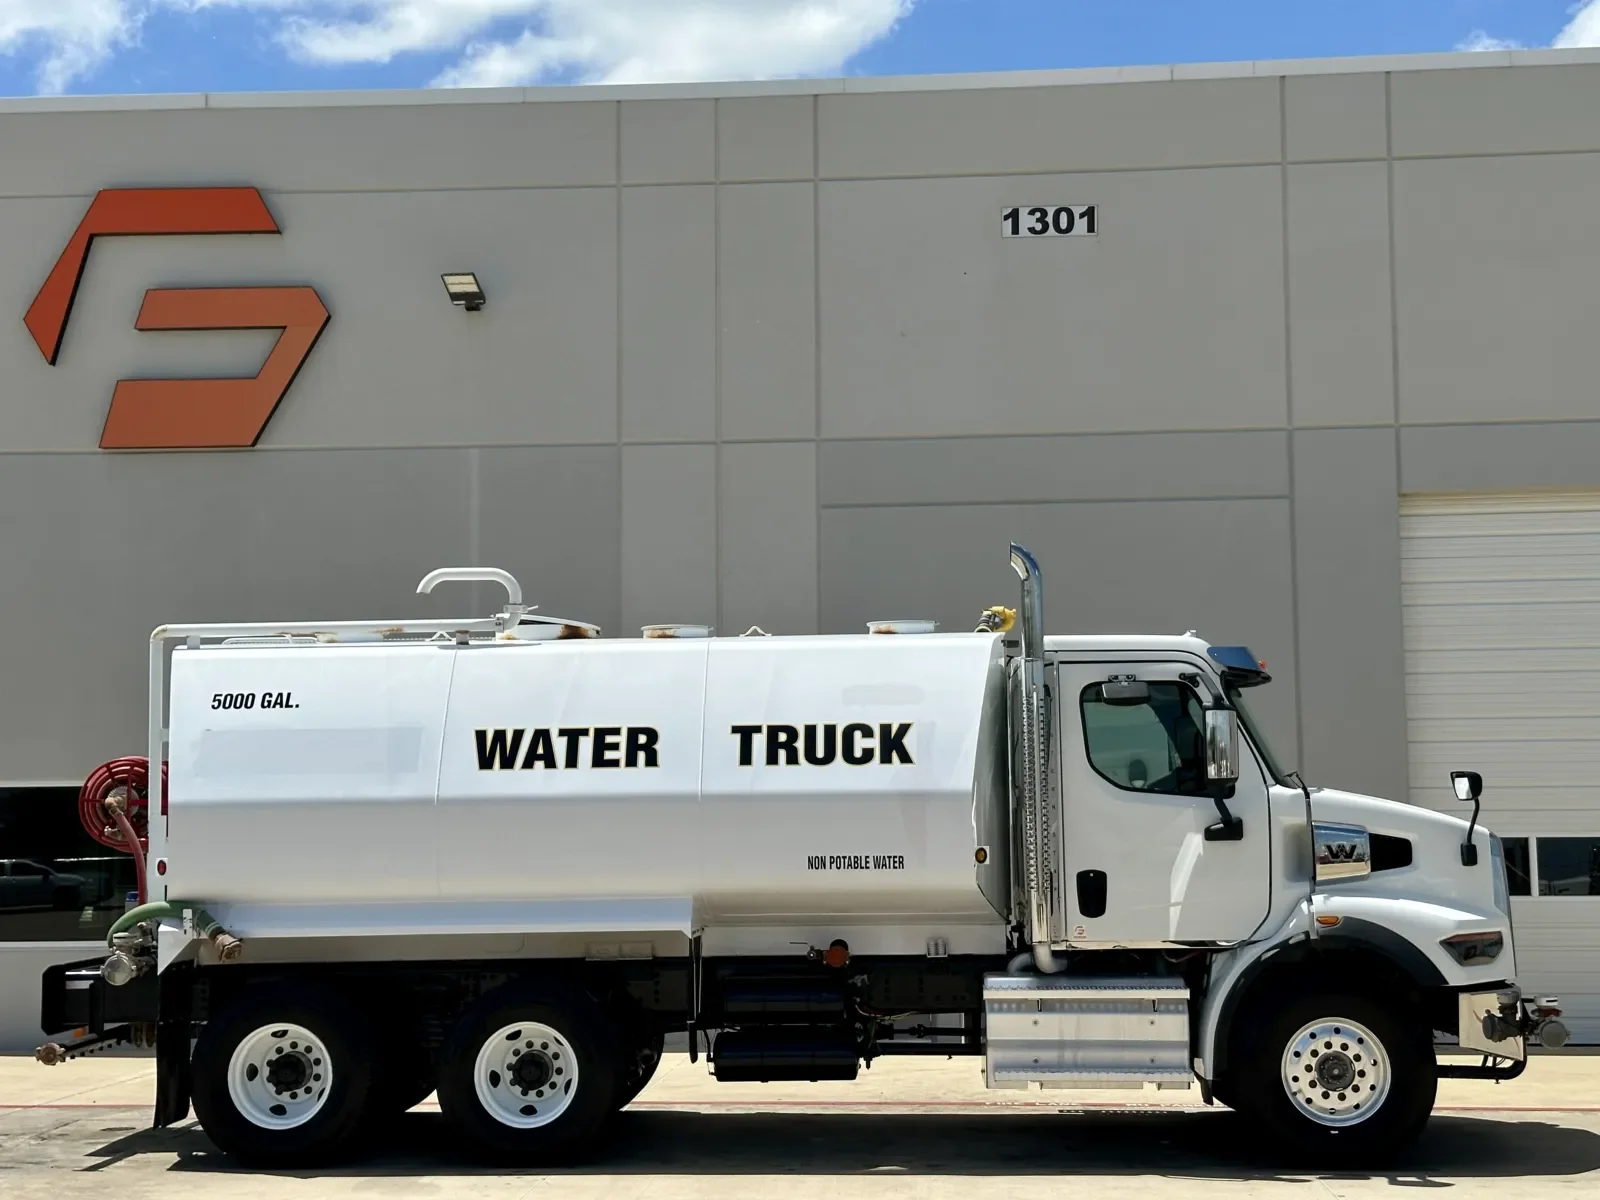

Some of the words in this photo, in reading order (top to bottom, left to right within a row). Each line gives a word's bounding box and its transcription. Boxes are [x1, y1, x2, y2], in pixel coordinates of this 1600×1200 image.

[1002, 205, 1097, 237] 1301
[211, 692, 256, 710] 5000
[260, 692, 300, 709] GAL.
[474, 725, 661, 772] WATER
[730, 722, 917, 766] TRUCK
[807, 856, 827, 870] NON
[829, 856, 870, 870] POTABLE
[872, 855, 905, 870] WATER
